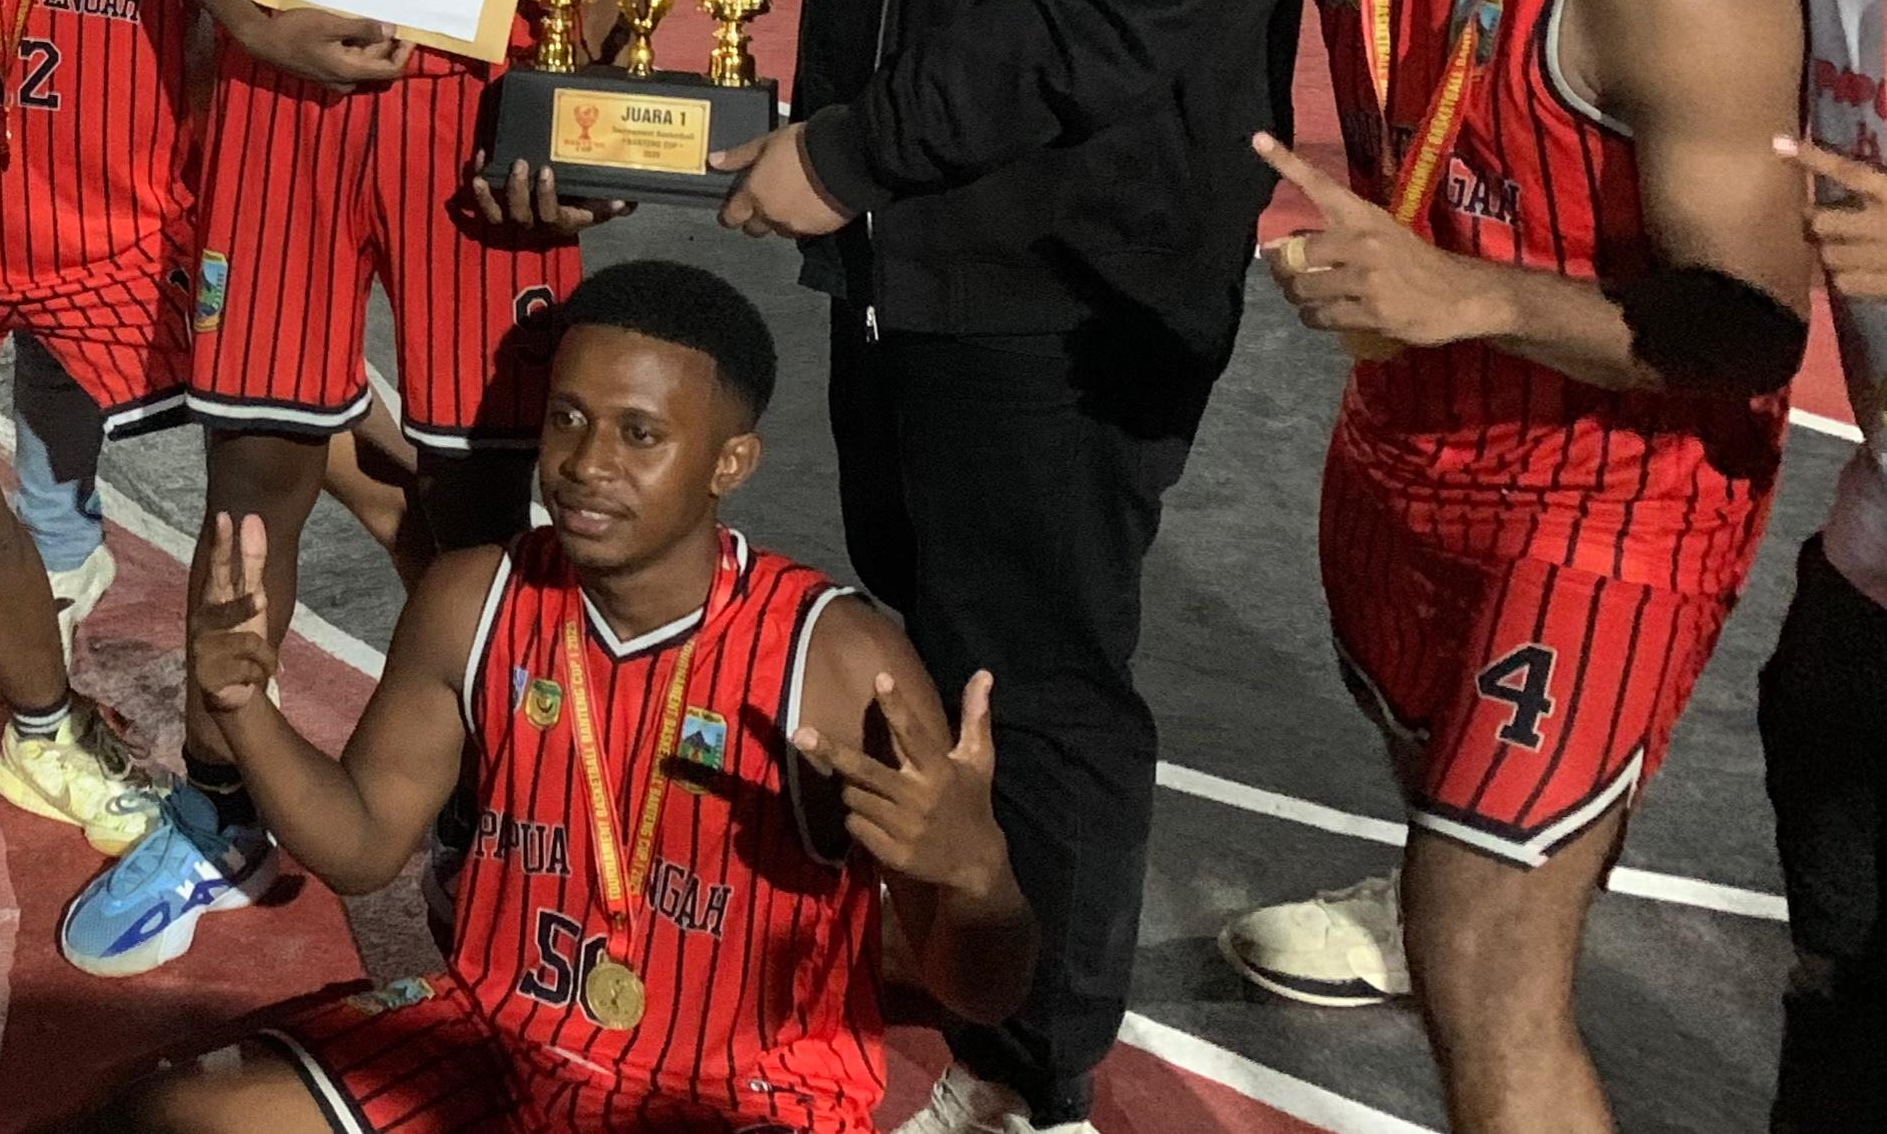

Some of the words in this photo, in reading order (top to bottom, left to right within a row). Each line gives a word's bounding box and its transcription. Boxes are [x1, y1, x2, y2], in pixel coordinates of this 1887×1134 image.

[620, 105, 674, 126] JUARA
[563, 620, 578, 650] 2025
[569, 660, 582, 685] CUP
[1475, 642, 1558, 753] 4
[573, 687, 592, 743] BANTENG
[582, 745, 607, 818] BASKETBALL
[597, 819, 621, 901] TOURNAMENT
